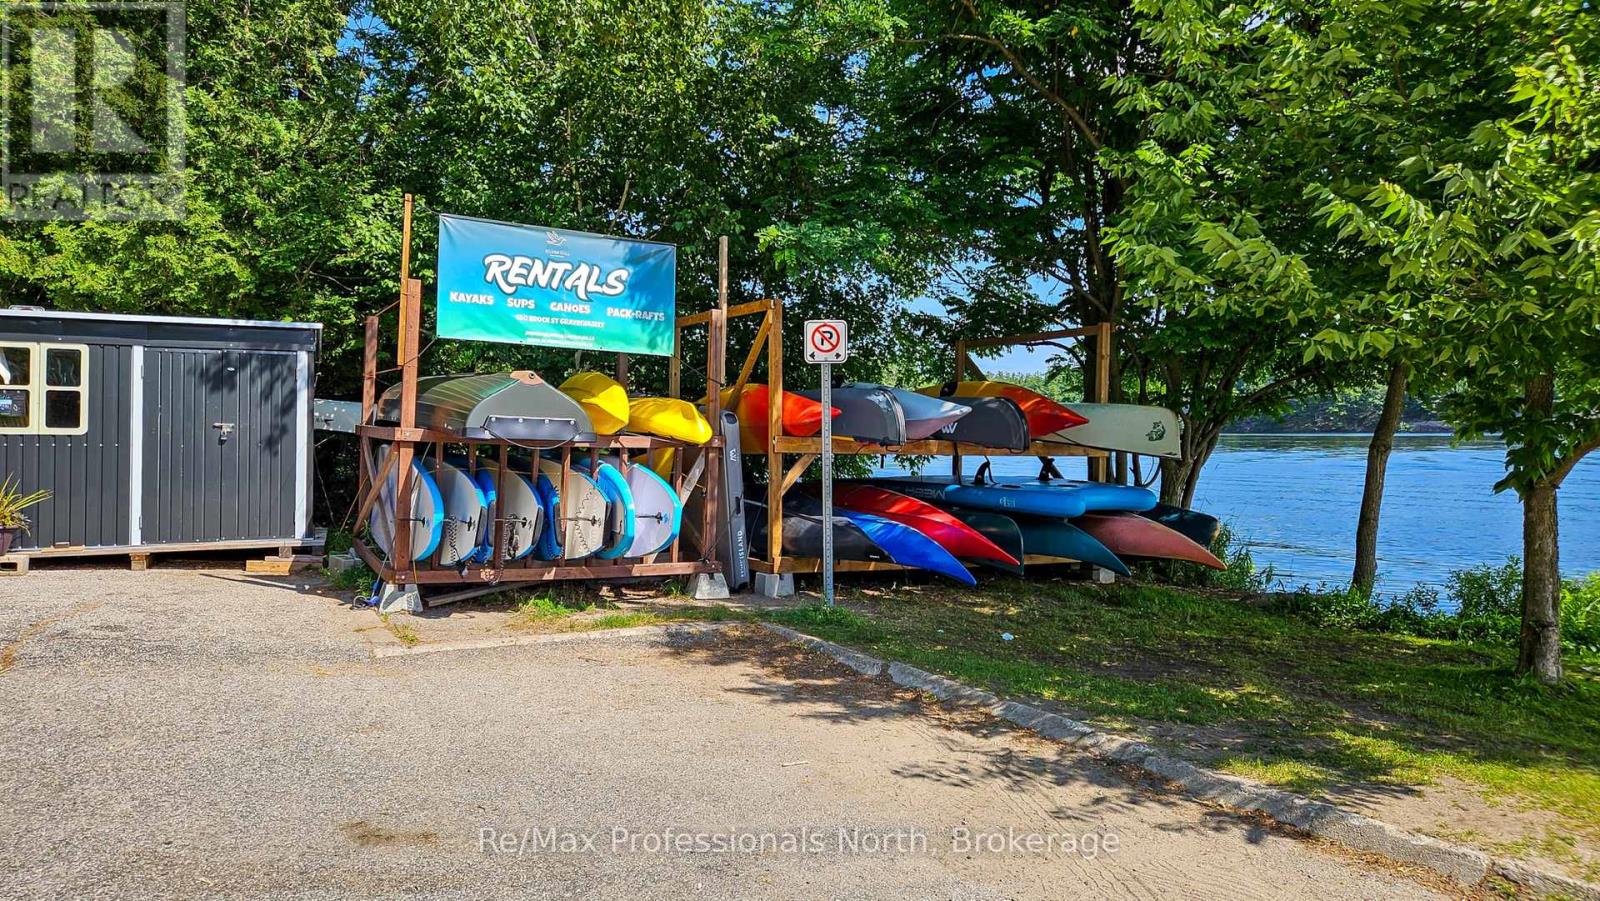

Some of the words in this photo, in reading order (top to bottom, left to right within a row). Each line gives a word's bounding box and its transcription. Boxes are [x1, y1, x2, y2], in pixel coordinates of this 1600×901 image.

[483, 253, 629, 301] RENTALS
[449, 291, 494, 305] KAYAKS
[507, 297, 535, 309] SUPS
[550, 302, 591, 314] CANOES
[737, 530, 745, 559] ISLAND
